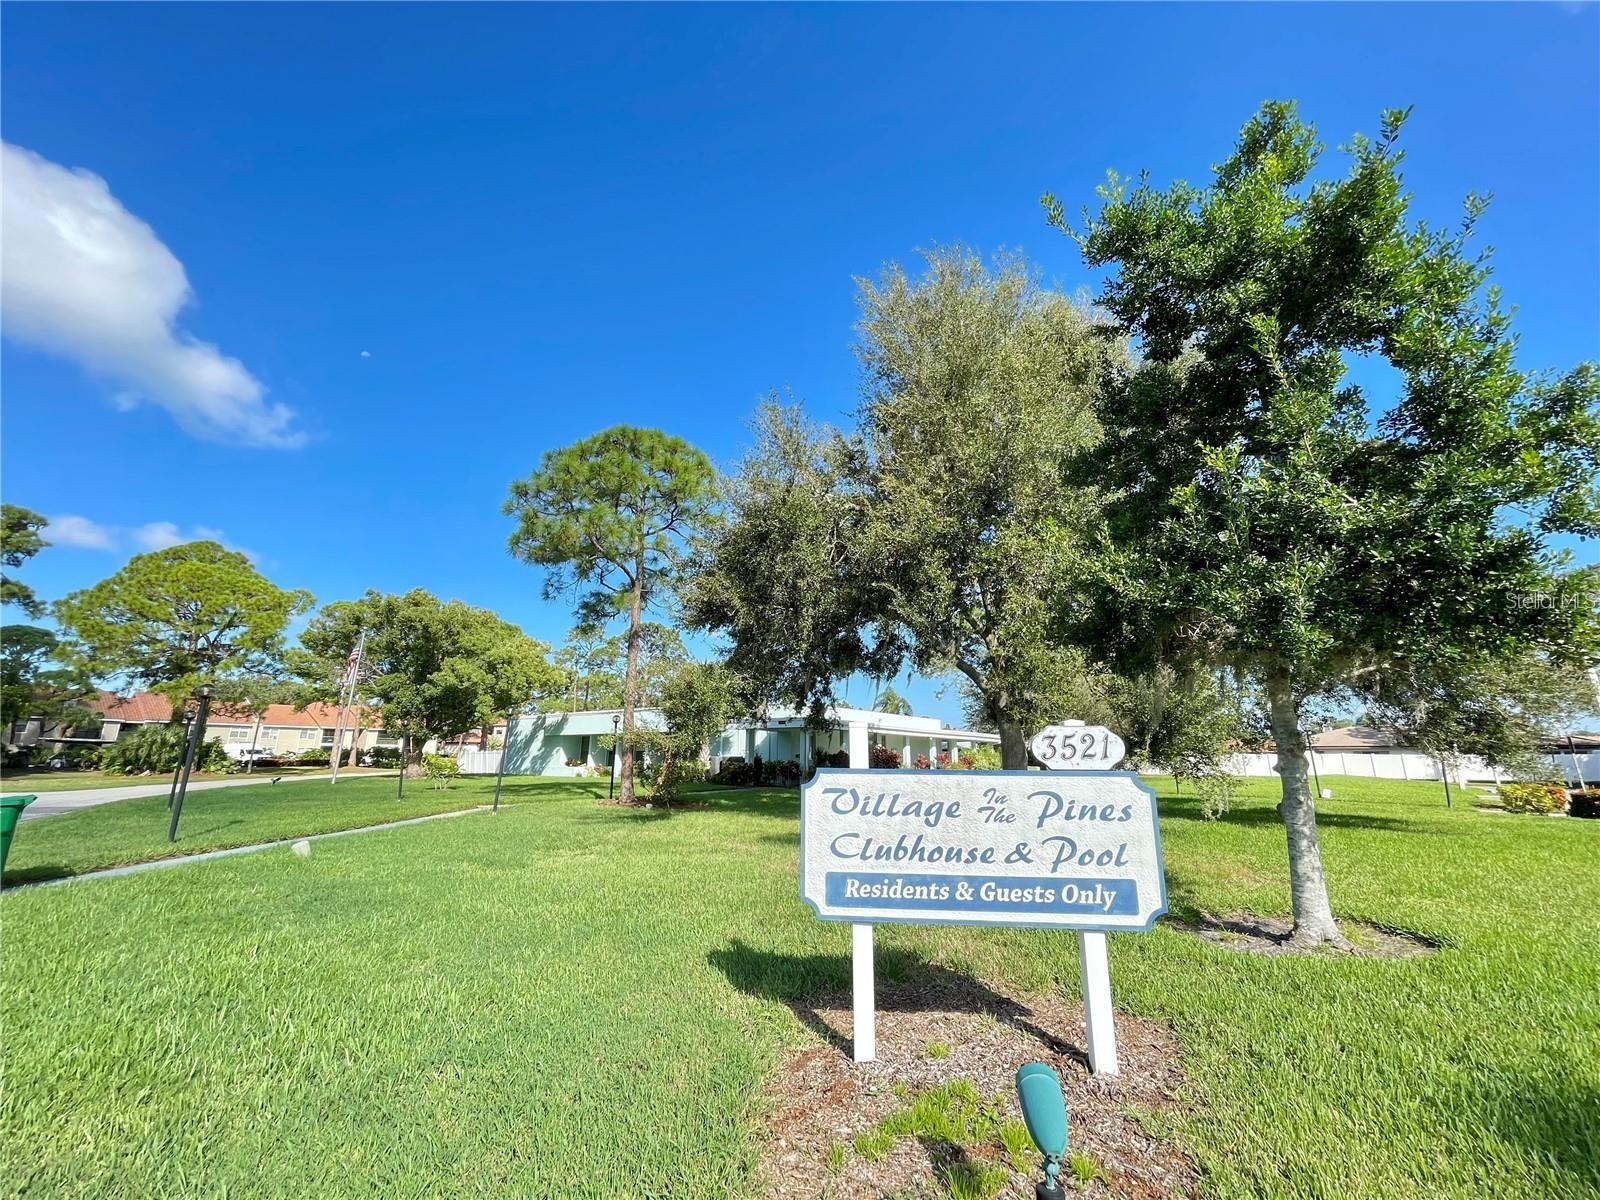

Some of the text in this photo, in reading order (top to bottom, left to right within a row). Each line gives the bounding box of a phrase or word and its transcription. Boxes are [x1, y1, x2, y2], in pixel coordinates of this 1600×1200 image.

[1041, 733, 1111, 762] 3521
[822, 787, 1133, 829] Village In The Pines
[830, 832, 1129, 874] Clubhouse & Pool
[845, 879, 1117, 912] Residents & Guests Only
